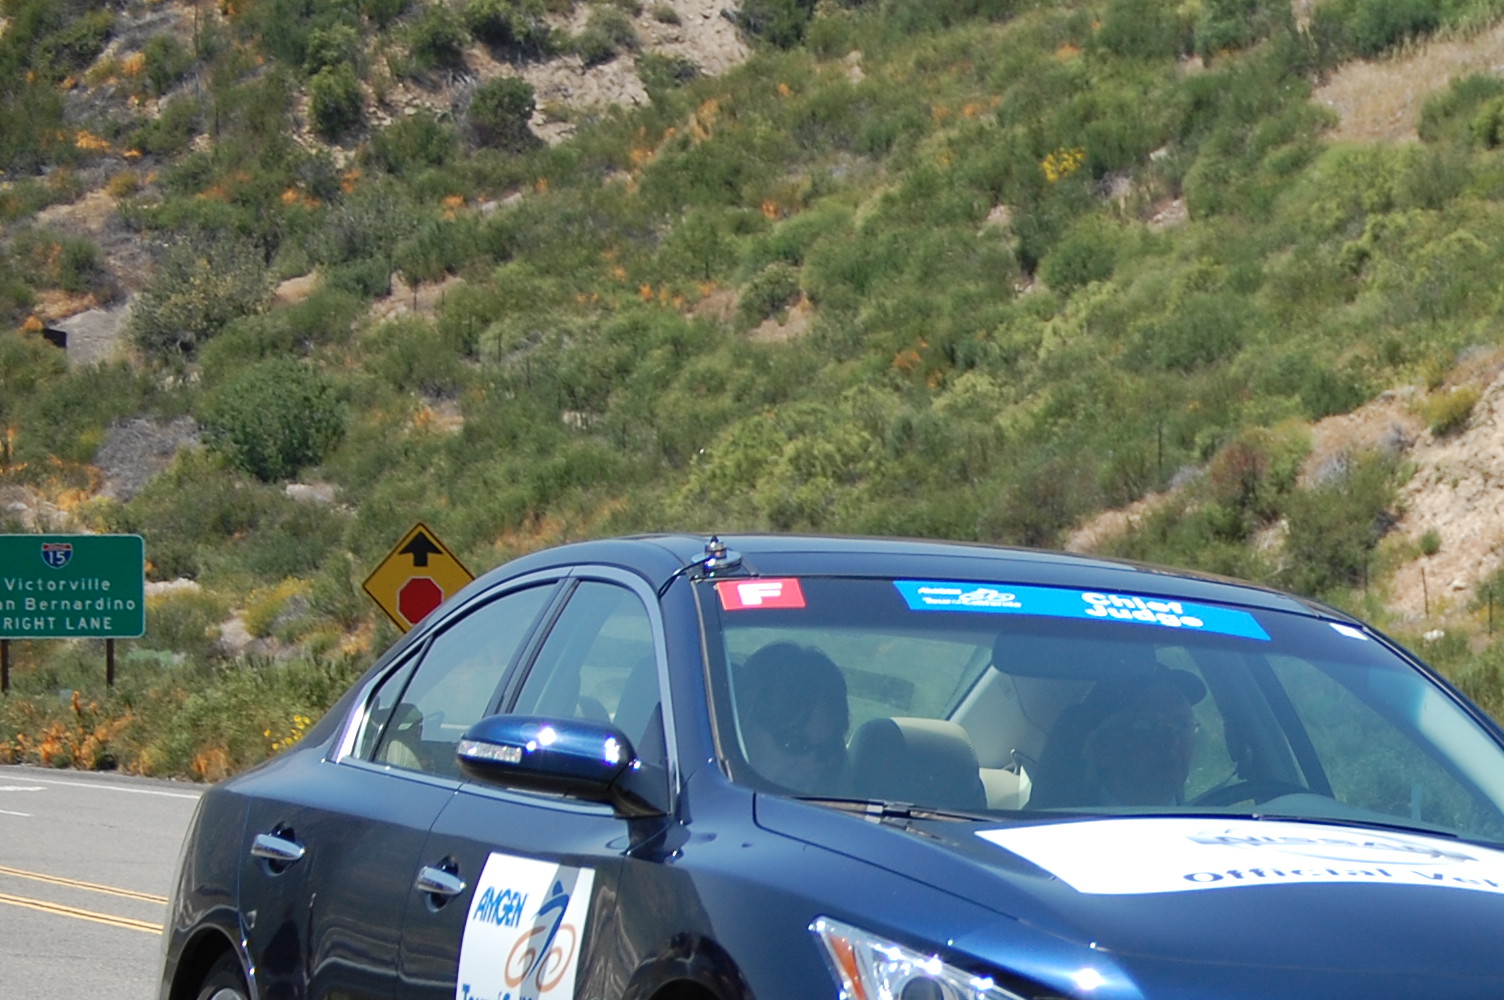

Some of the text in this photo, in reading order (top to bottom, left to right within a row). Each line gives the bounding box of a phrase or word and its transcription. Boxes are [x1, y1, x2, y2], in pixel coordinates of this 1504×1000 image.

[49, 551, 66, 565] 15
[4, 577, 111, 591] Victorville
[737, 582, 783, 605] F
[24, 597, 136, 611] Bernardino
[1081, 592, 1183, 614] Chief
[3, 616, 113, 630] RIGHT LANE
[1084, 604, 1204, 627] Judge
[472, 886, 529, 928] AMGEN
